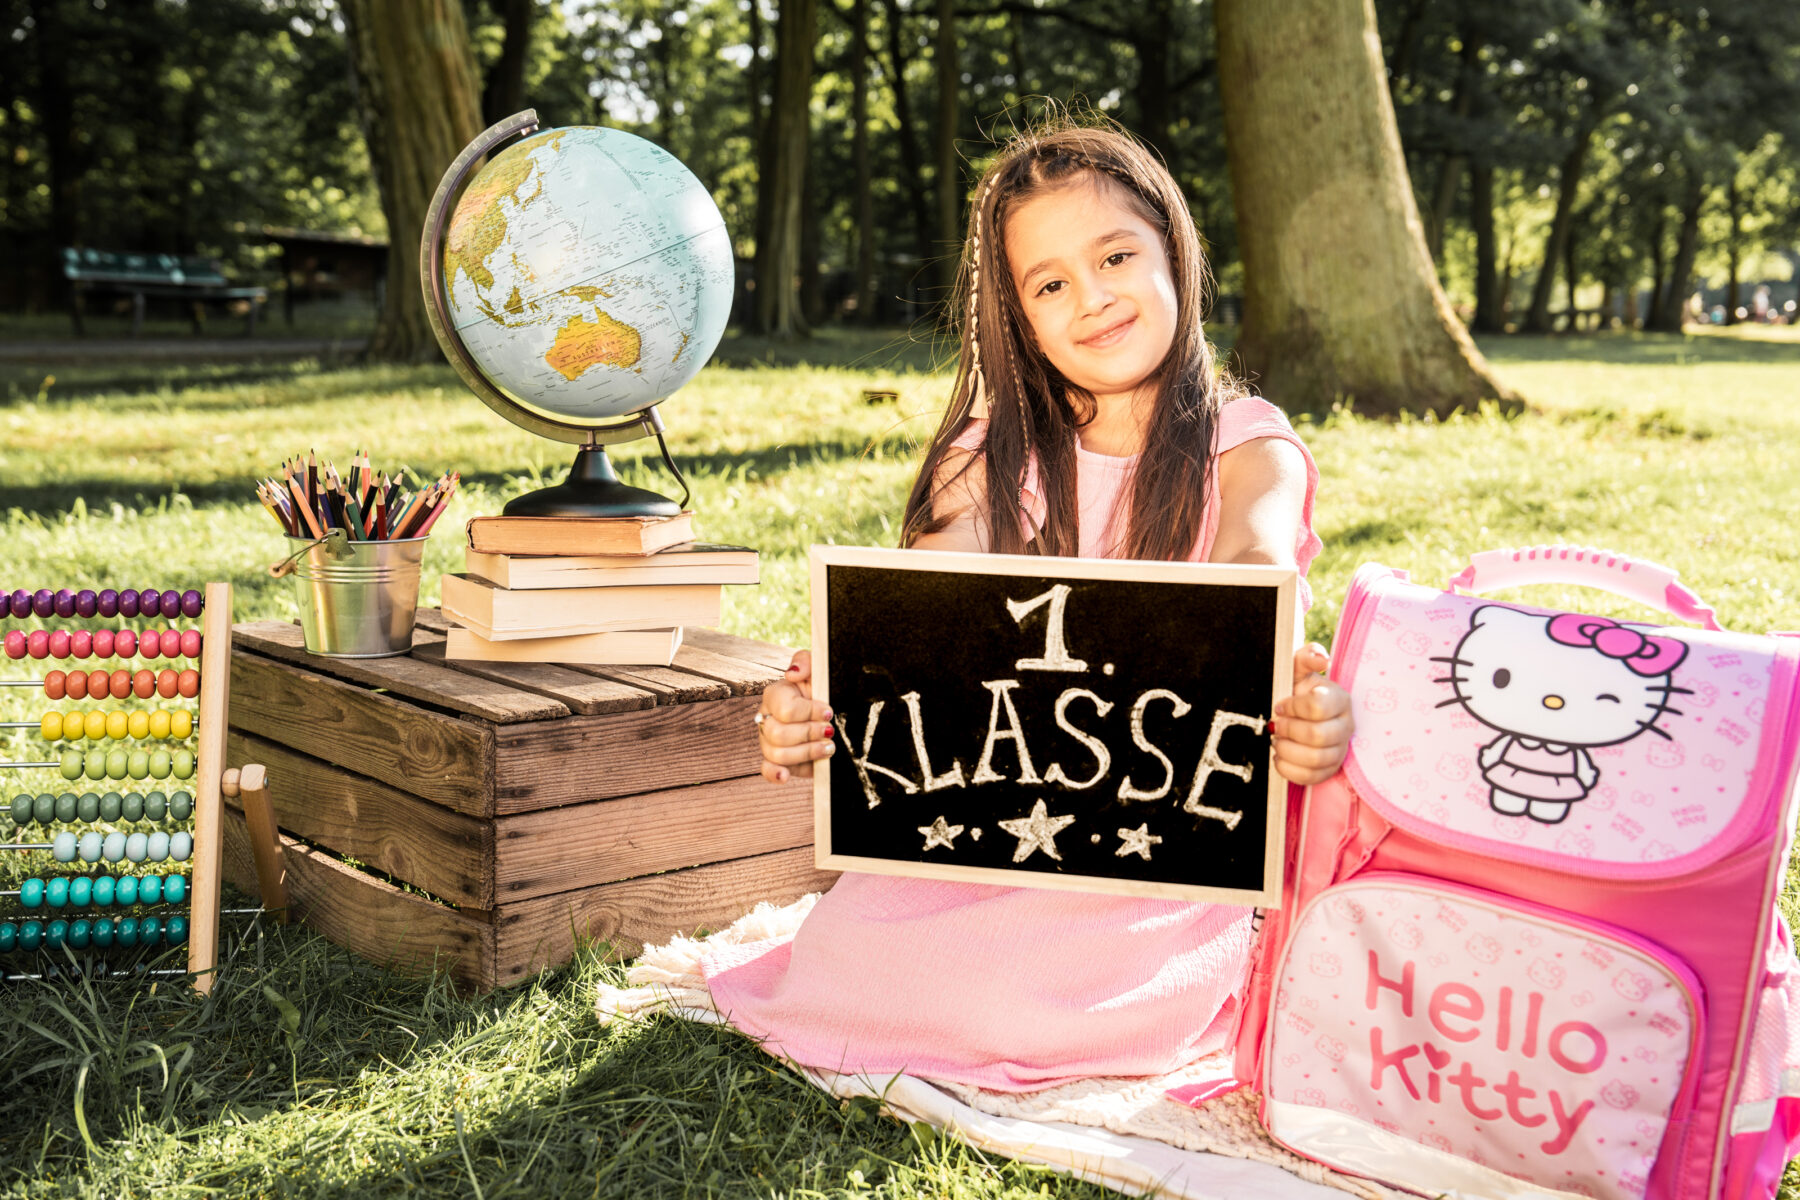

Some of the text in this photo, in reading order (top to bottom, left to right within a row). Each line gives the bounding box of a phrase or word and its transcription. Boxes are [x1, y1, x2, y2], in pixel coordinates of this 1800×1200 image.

[1006, 584, 1115, 676] 1.
[834, 679, 1265, 831] KLASSE
[1366, 949, 1608, 1074] Hello
[1370, 1026, 1595, 1155] Kitty
